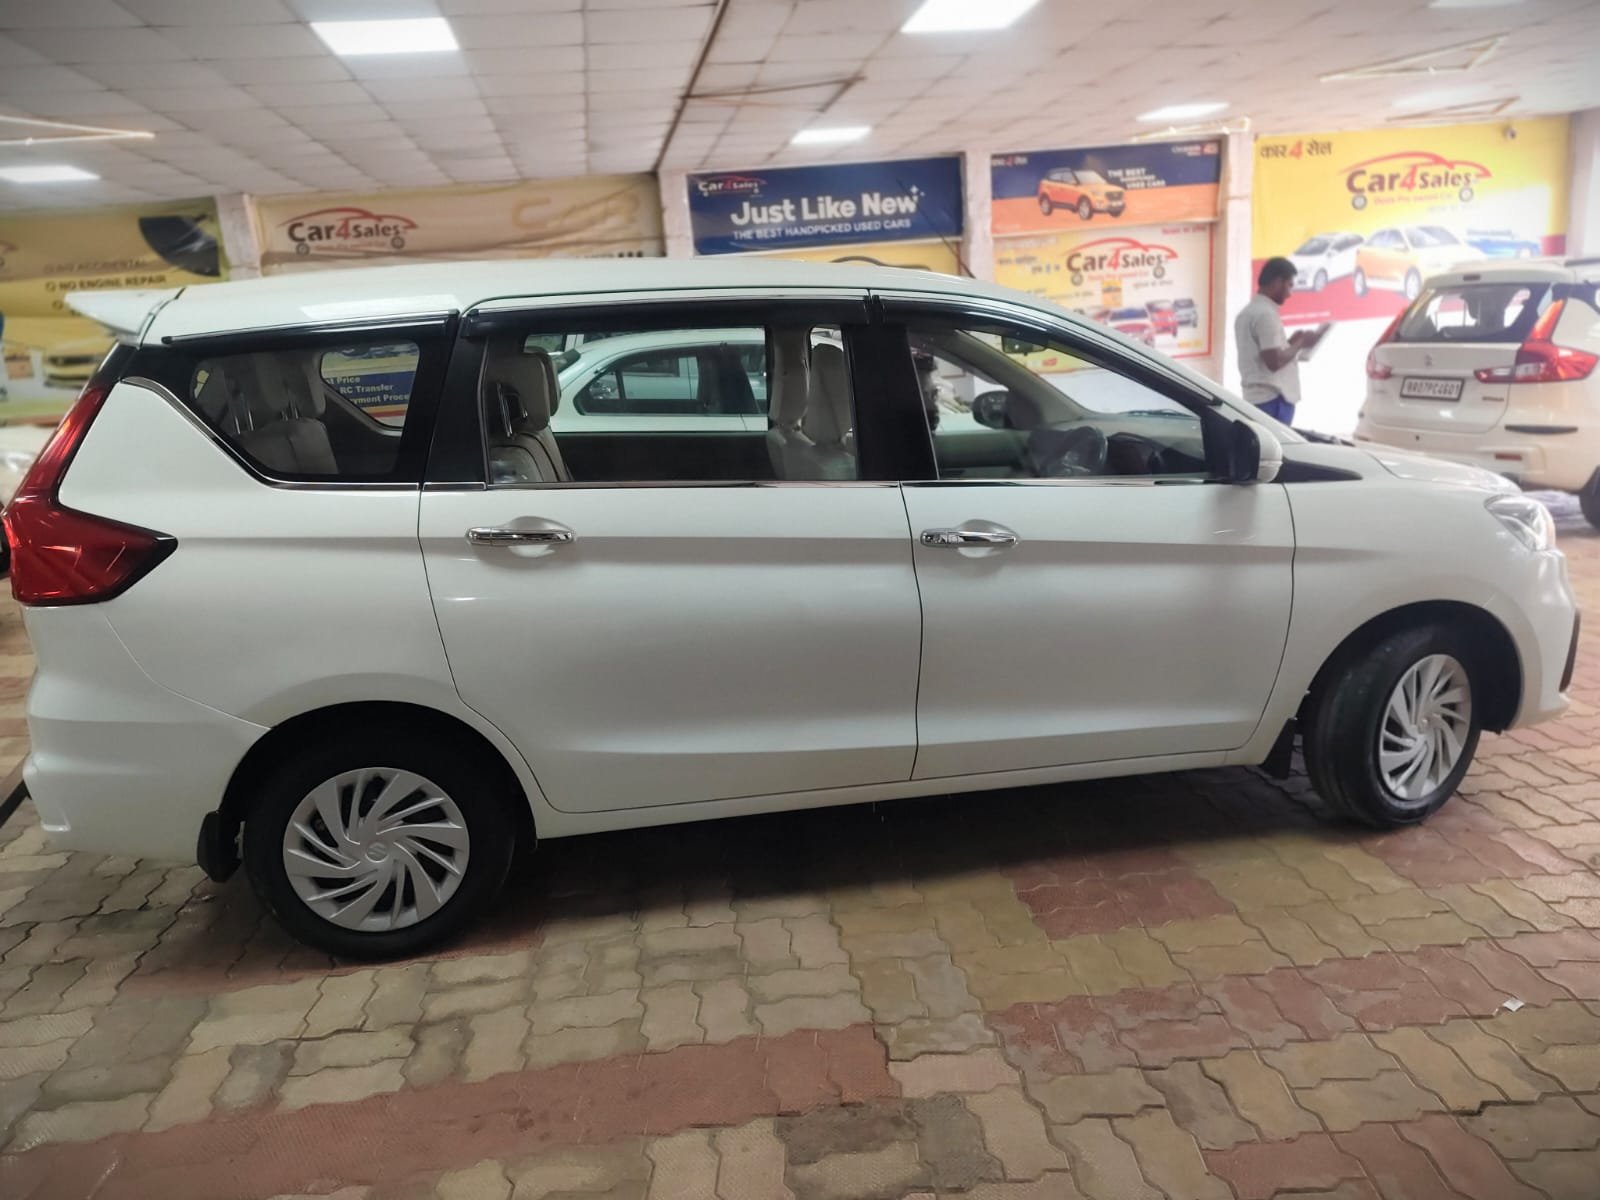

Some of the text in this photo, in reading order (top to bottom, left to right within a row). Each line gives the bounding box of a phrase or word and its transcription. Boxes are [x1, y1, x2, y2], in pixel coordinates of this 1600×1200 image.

[729, 192, 919, 226] Just Like New
[733, 218, 912, 241] THE BEST HANDPICKED USED CARS
[59, 275, 167, 290] NO ENGINE REPAIR
[337, 376, 361, 384] Price
[340, 384, 394, 394] RC Transfer
